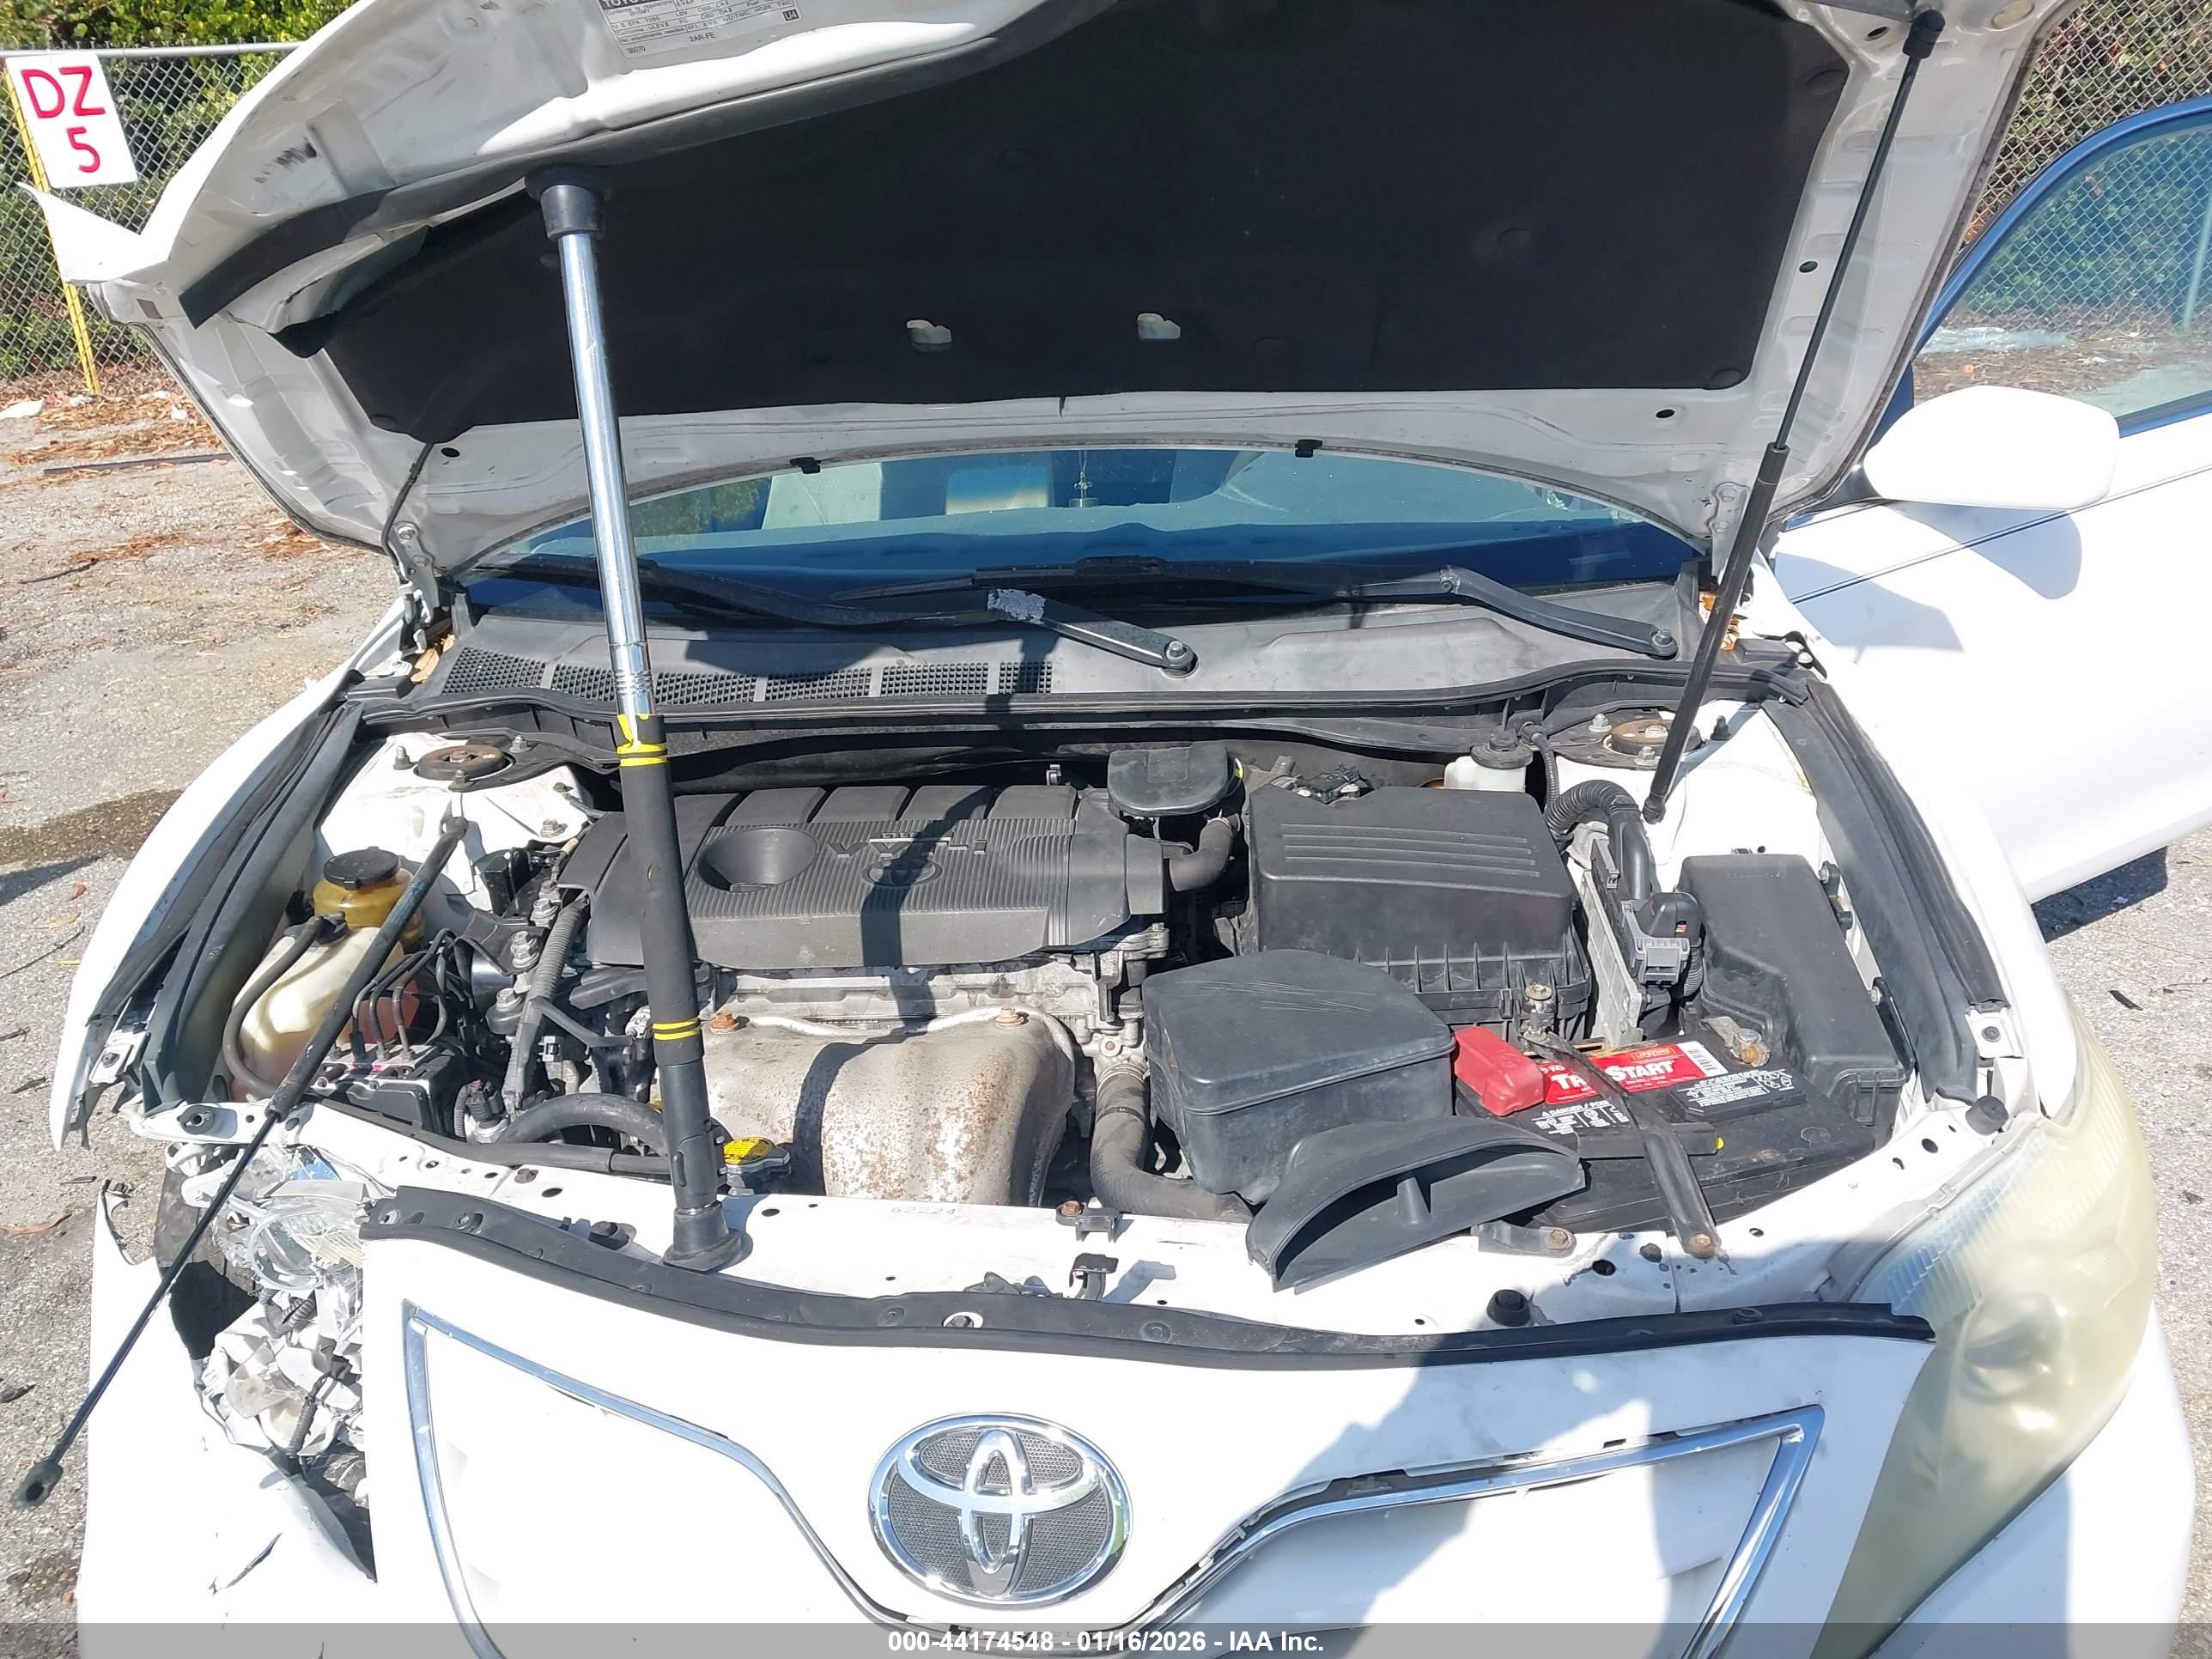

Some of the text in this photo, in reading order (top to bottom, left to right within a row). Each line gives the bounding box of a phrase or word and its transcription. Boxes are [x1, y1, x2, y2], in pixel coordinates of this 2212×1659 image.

[784, 9, 798, 21] U4
[689, 32, 715, 41] 2AR-FE
[21, 66, 106, 118] DZ
[66, 126, 100, 173] 5
[1604, 1060, 1674, 1082] START
